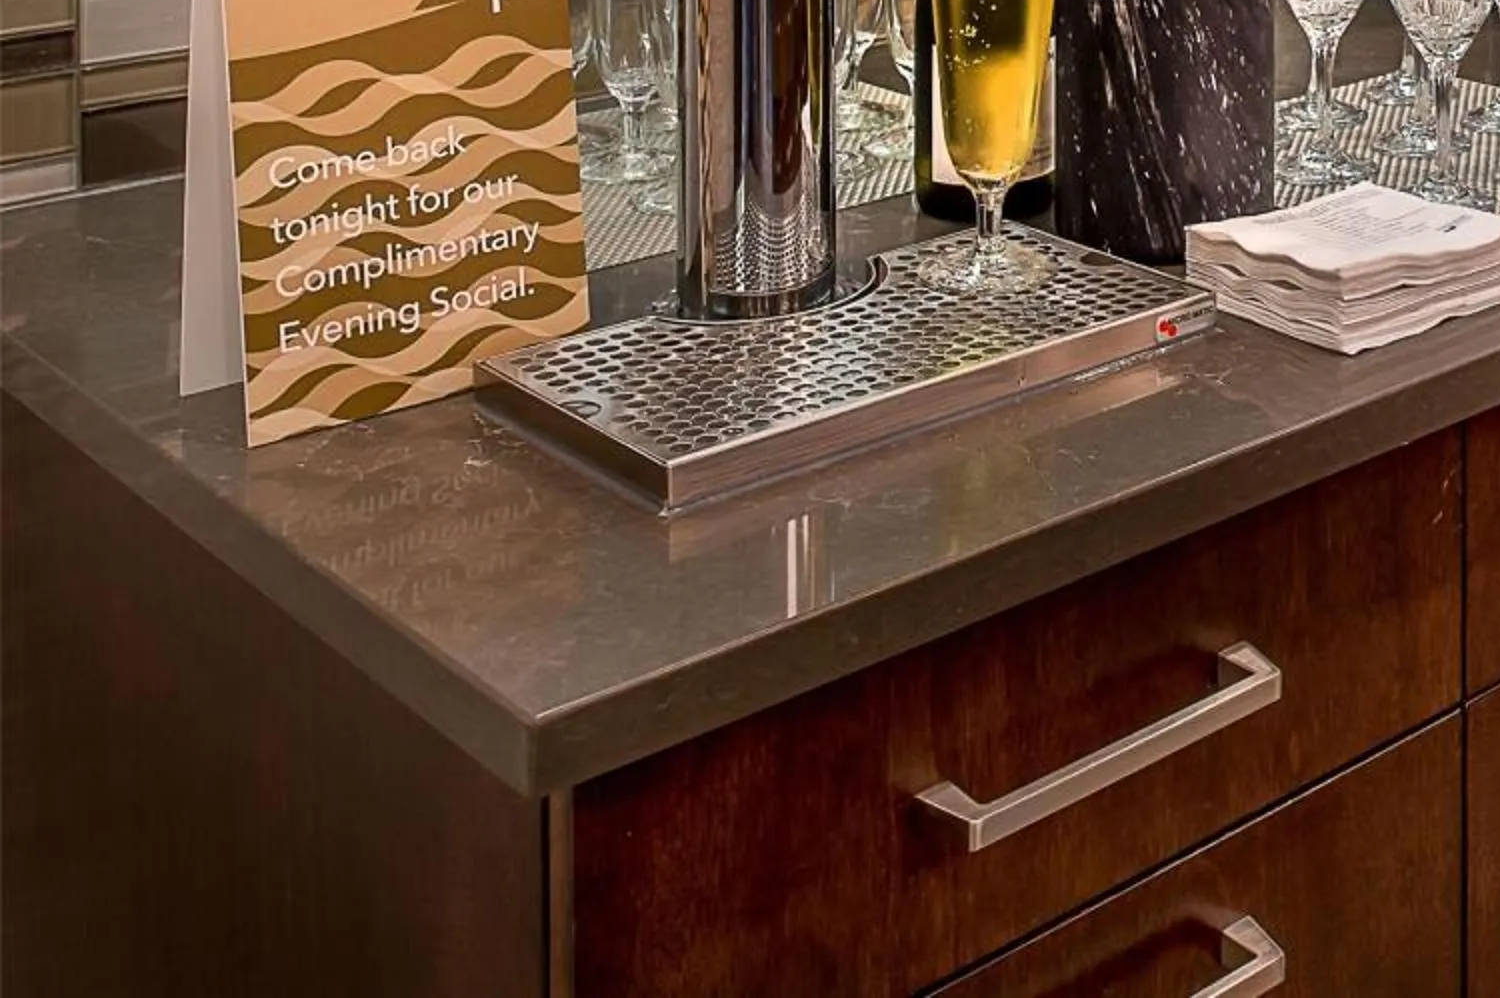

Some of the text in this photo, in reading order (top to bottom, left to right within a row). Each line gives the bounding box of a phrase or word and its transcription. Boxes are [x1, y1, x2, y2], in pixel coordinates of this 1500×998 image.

[269, 125, 468, 189] Come back
[271, 173, 519, 244] tonight for our
[275, 221, 540, 298] Complimentary
[278, 266, 536, 354] Evening Social.
